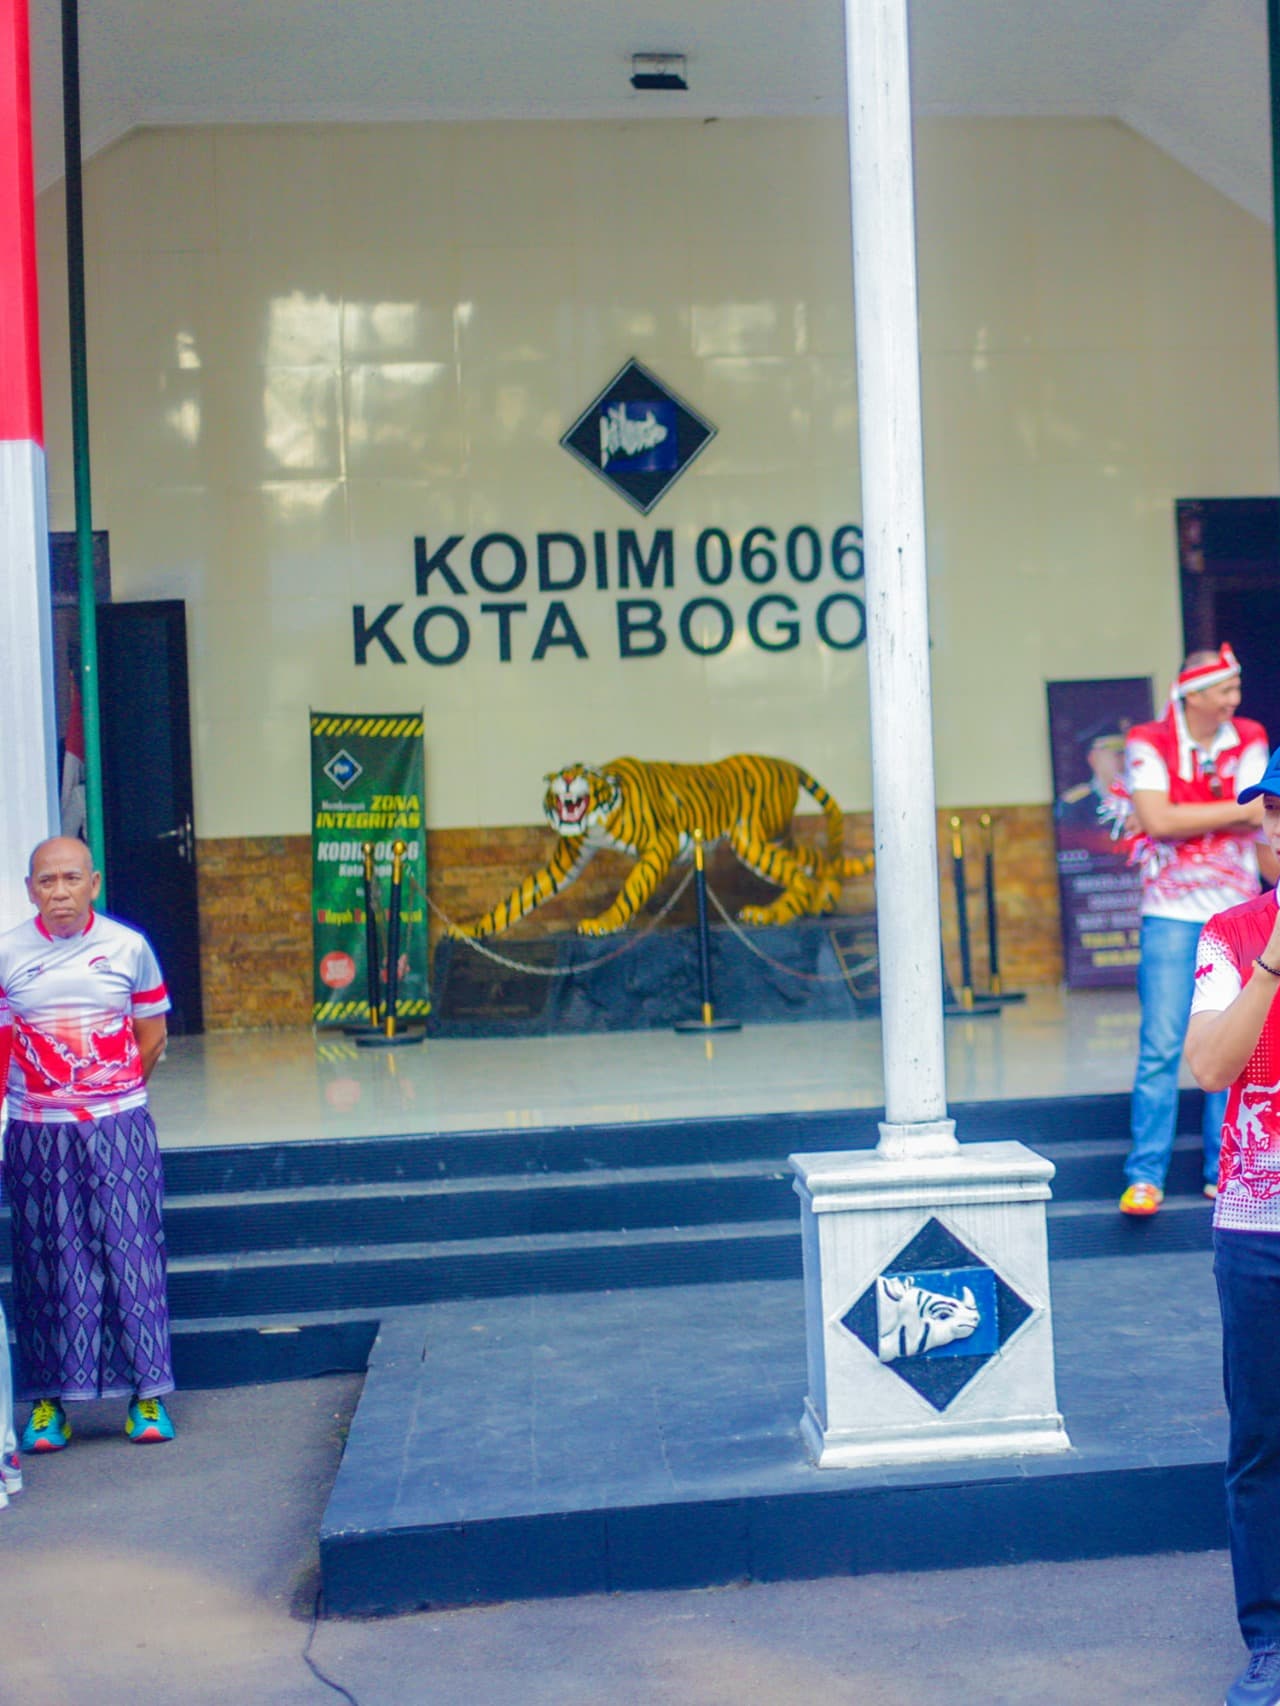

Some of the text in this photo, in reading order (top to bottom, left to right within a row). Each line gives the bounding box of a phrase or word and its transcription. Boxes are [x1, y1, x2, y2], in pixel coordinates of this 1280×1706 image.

[412, 525, 864, 596] KODIM 0606
[352, 592, 933, 666] KOTA BOGO
[316, 811, 420, 829] INTEGRITAS
[370, 794, 419, 811] ZONA
